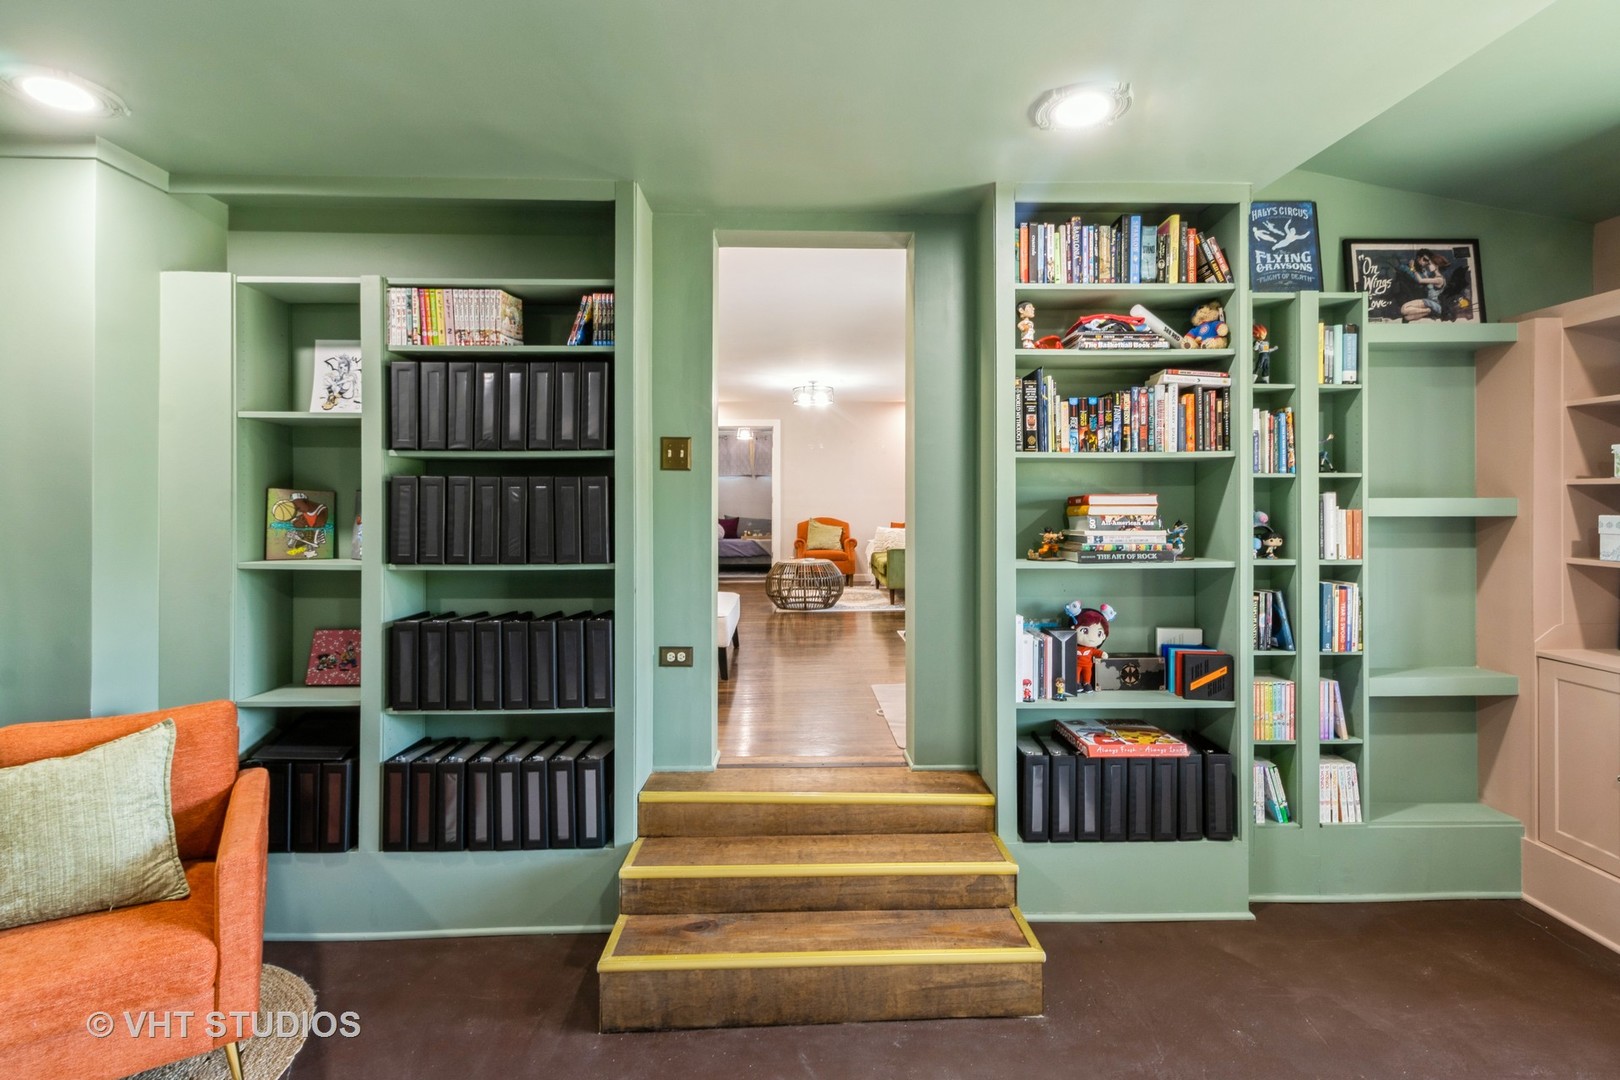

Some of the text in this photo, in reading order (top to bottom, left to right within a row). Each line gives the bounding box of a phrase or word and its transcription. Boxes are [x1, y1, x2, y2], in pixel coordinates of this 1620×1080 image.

[1251, 206, 1309, 222] HALY'S CIRCUS
[1255, 250, 1312, 264] FLYING
[1256, 263, 1313, 273] GRAYSONS
[1363, 275, 1393, 297] Wings
[1084, 341, 1099, 349] The
[1100, 341, 1133, 349] Basketball
[1133, 341, 1151, 349] Book
[1101, 519, 1142, 527] All-American
[1096, 746, 1119, 755] Always
[1145, 746, 1167, 755] Always
